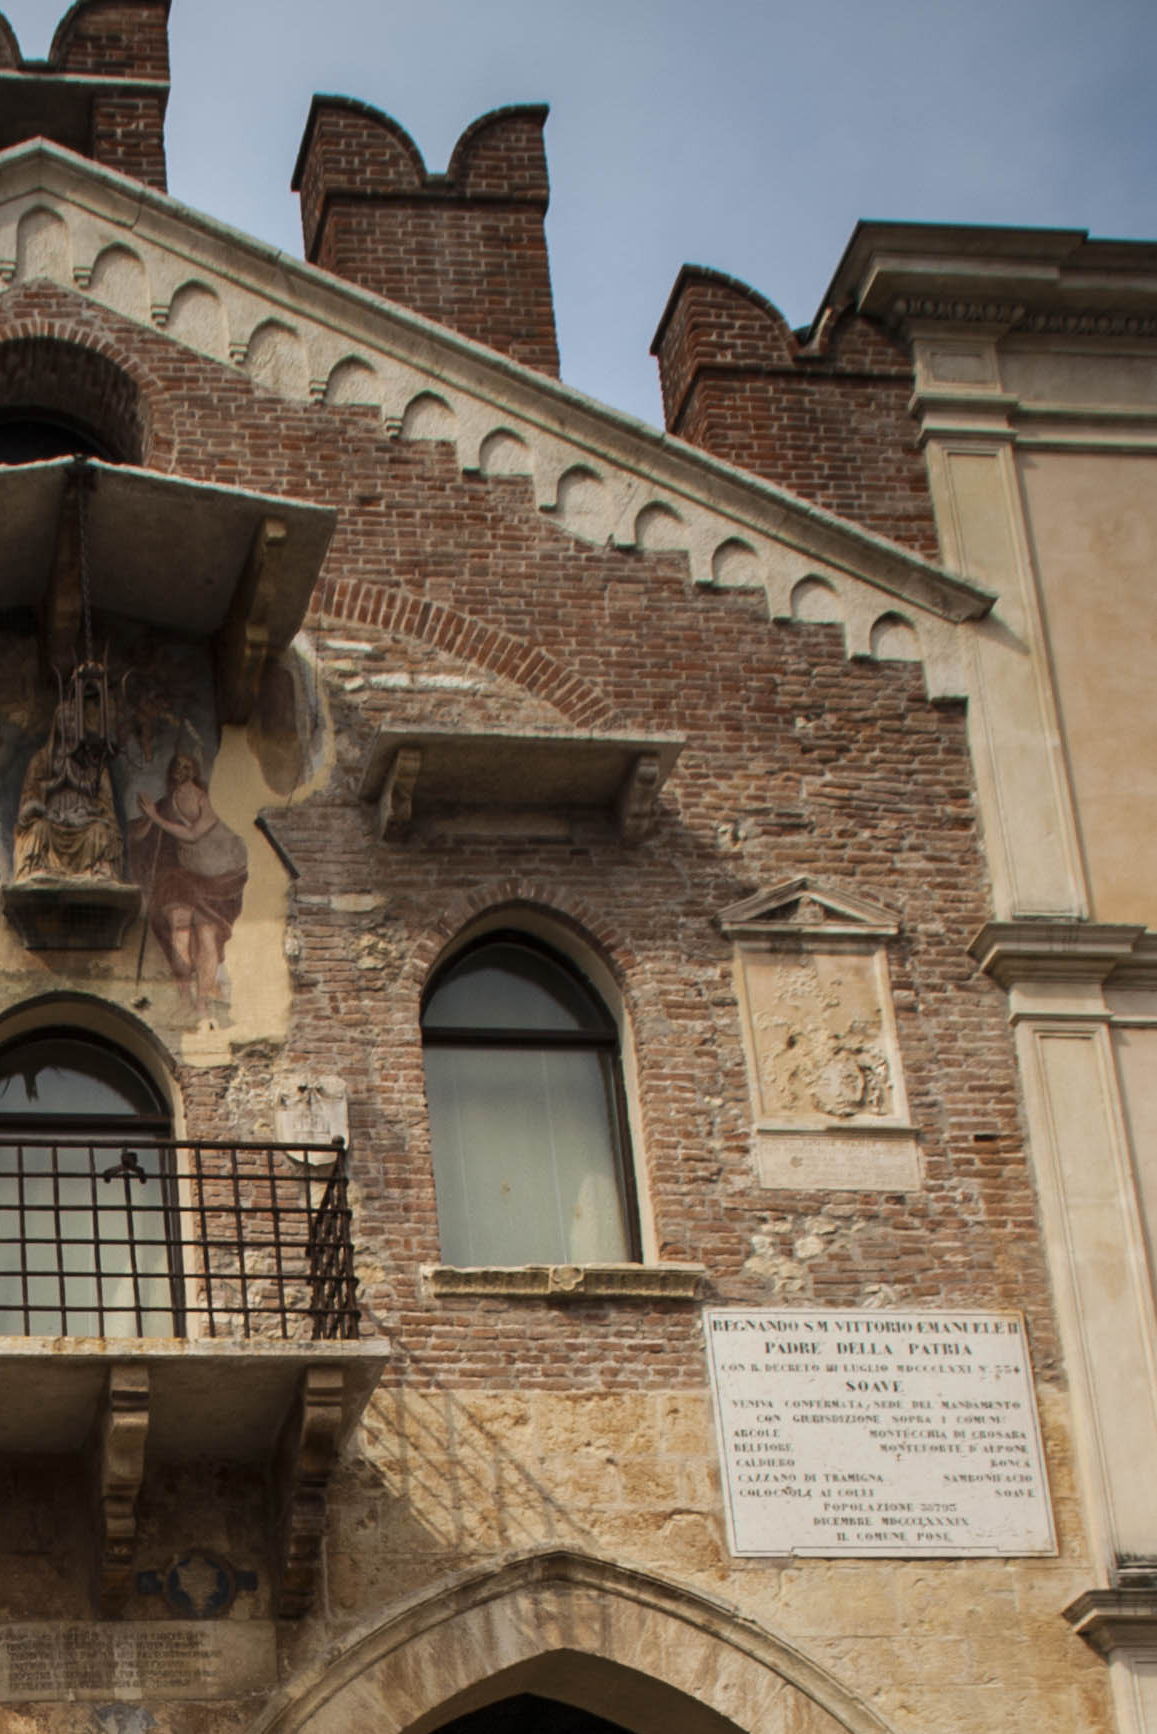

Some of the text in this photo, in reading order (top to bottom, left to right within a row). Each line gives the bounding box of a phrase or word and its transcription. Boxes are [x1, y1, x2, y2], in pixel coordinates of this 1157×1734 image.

[712, 1320, 799, 1332] REGNANDO
[835, 1321, 913, 1333] VITTORIO
[916, 1321, 1003, 1334] EMANUELE
[764, 1342, 972, 1355] PADRE DELLA PATRIA
[721, 1364, 746, 1373] CON
[765, 1364, 820, 1373] DECRETO
[843, 1364, 889, 1373] LUGLIO
[846, 1380, 904, 1393] SOAVE
[732, 1400, 774, 1409] VENIVA
[874, 1400, 901, 1409] SEDE
[911, 1401, 932, 1409] DEL
[941, 1401, 1021, 1410] MANDAMENTO
[756, 1414, 782, 1423] CON
[793, 1415, 881, 1424] GIURISDIZIONE
[891, 1415, 932, 1424] SOPRA
[734, 1429, 780, 1438] ARCOLE
[869, 1430, 1027, 1440] MONTECCHIA DI CROSARA
[734, 1443, 793, 1452] BELFIORE
[880, 1444, 961, 1453] MONTEFORTE
[736, 1458, 795, 1468] CALDIERO
[737, 1473, 884, 1483] CAZZANO DI TRAMIGNA
[837, 1488, 876, 1498] COLLI
[995, 1489, 1036, 1498] SOAVE
[823, 1503, 913, 1512] POPOLAZIONE
[813, 1517, 871, 1526] DICEMBRE
[836, 1532, 850, 1542] IL
[856, 1532, 907, 1542] COMUNE
